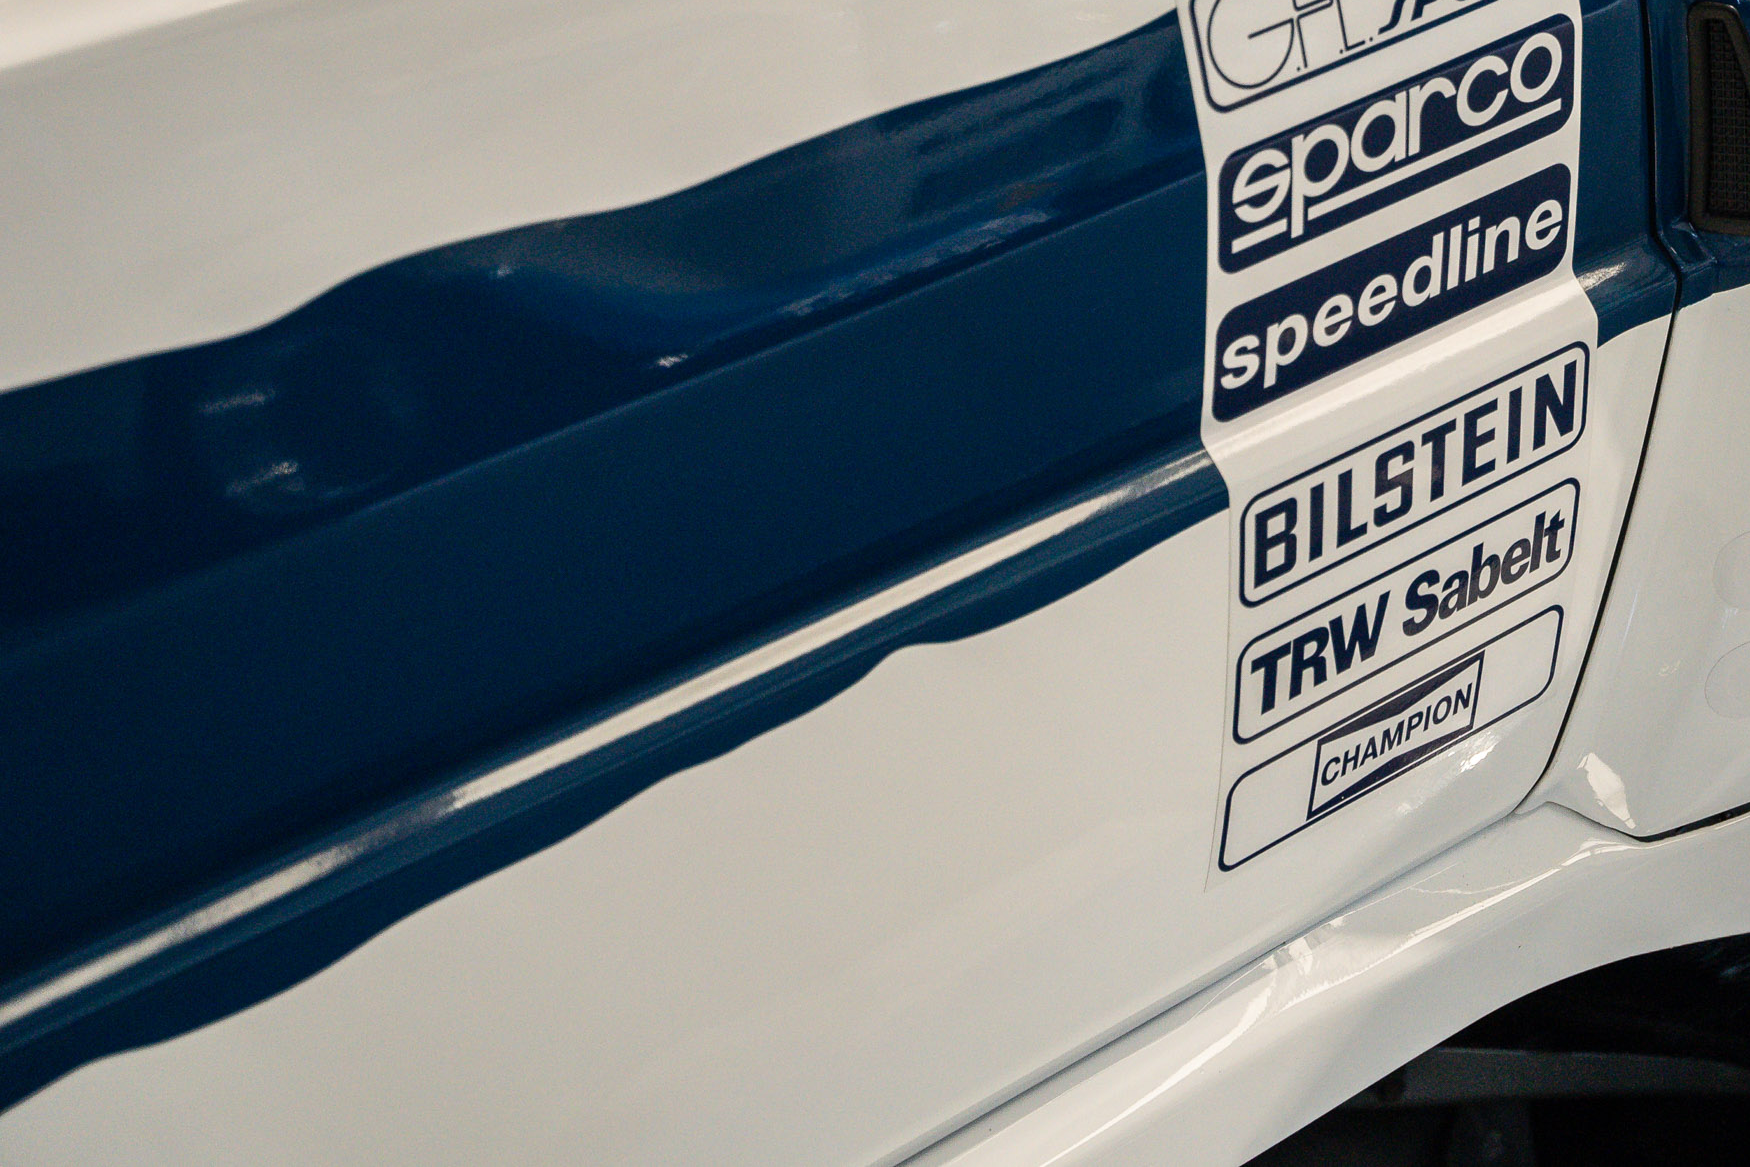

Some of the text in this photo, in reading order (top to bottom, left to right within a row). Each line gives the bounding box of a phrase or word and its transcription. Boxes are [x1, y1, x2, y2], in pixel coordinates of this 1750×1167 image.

[1231, 32, 1563, 239] sparco
[1219, 198, 1564, 390] speedline
[1253, 358, 1580, 590] BILSTEIN
[1250, 509, 1567, 717] TRW Sabelt
[1319, 682, 1474, 787] CHAMPION
